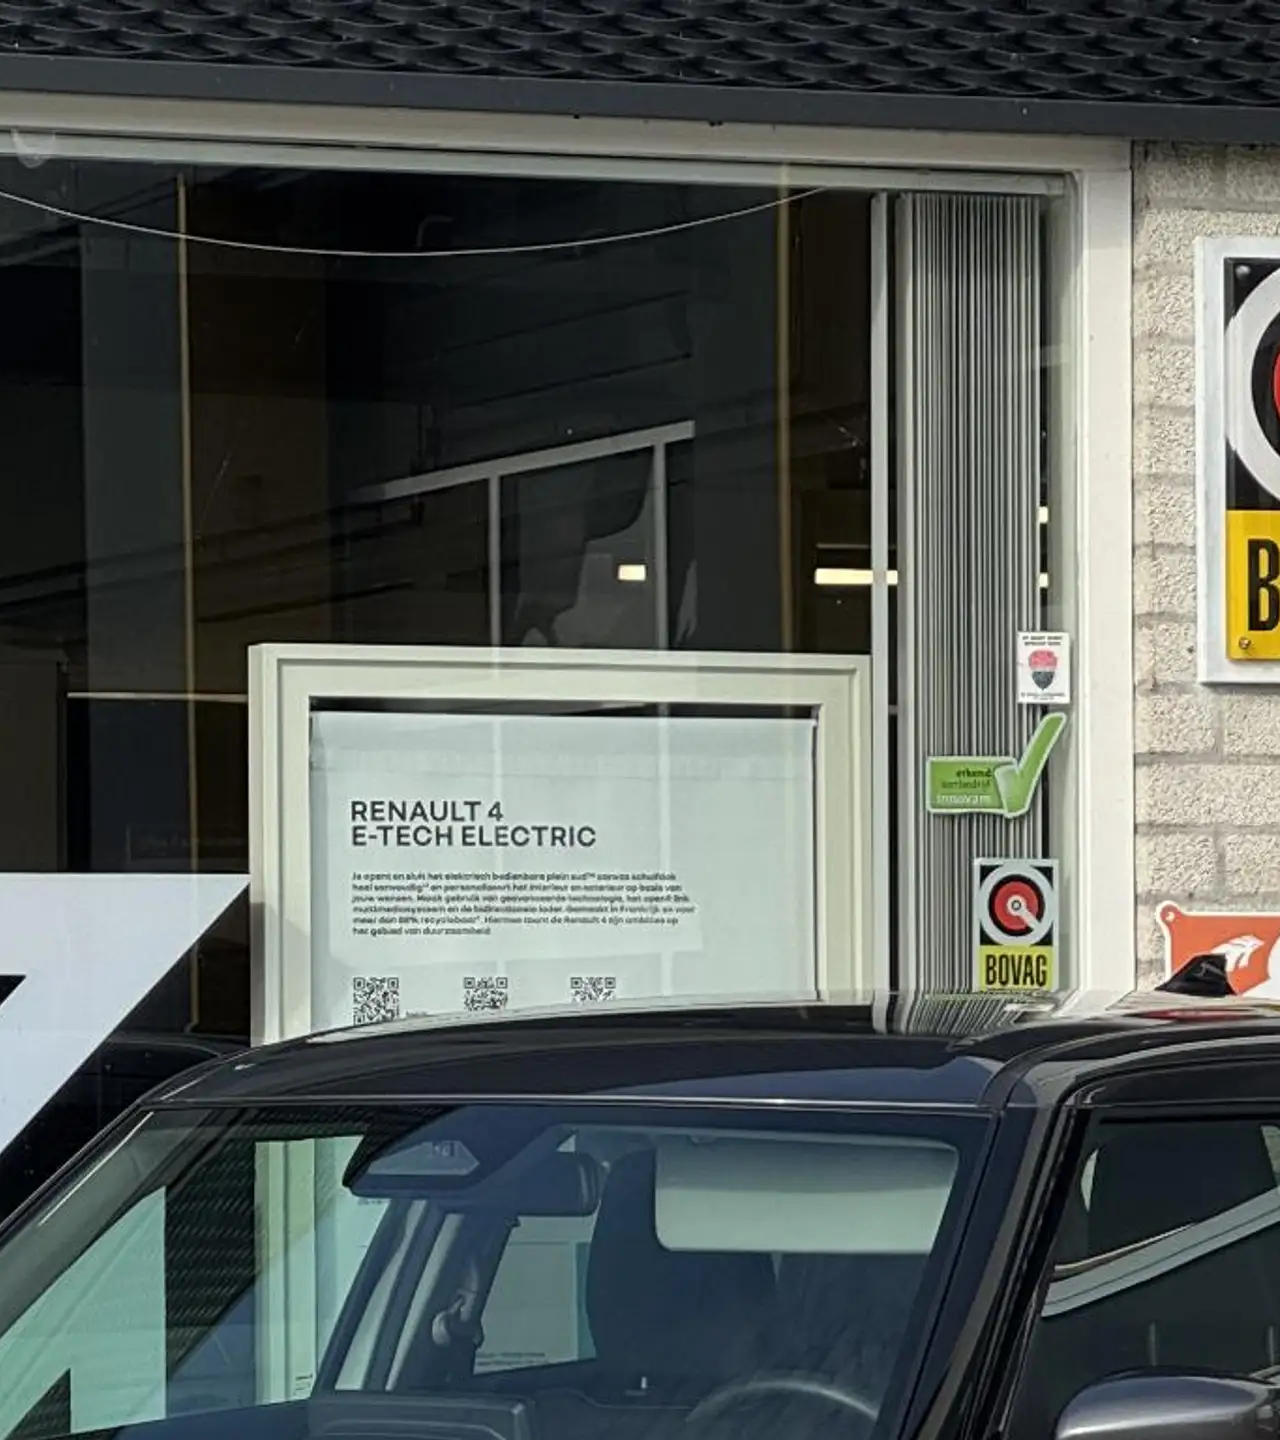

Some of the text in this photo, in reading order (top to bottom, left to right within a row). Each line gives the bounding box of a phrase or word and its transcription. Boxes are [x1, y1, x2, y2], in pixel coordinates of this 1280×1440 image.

[351, 800, 504, 822] RENAULT 4
[352, 825, 597, 847] E-TECH ELECTRIC
[985, 954, 1048, 991] BOVAG
